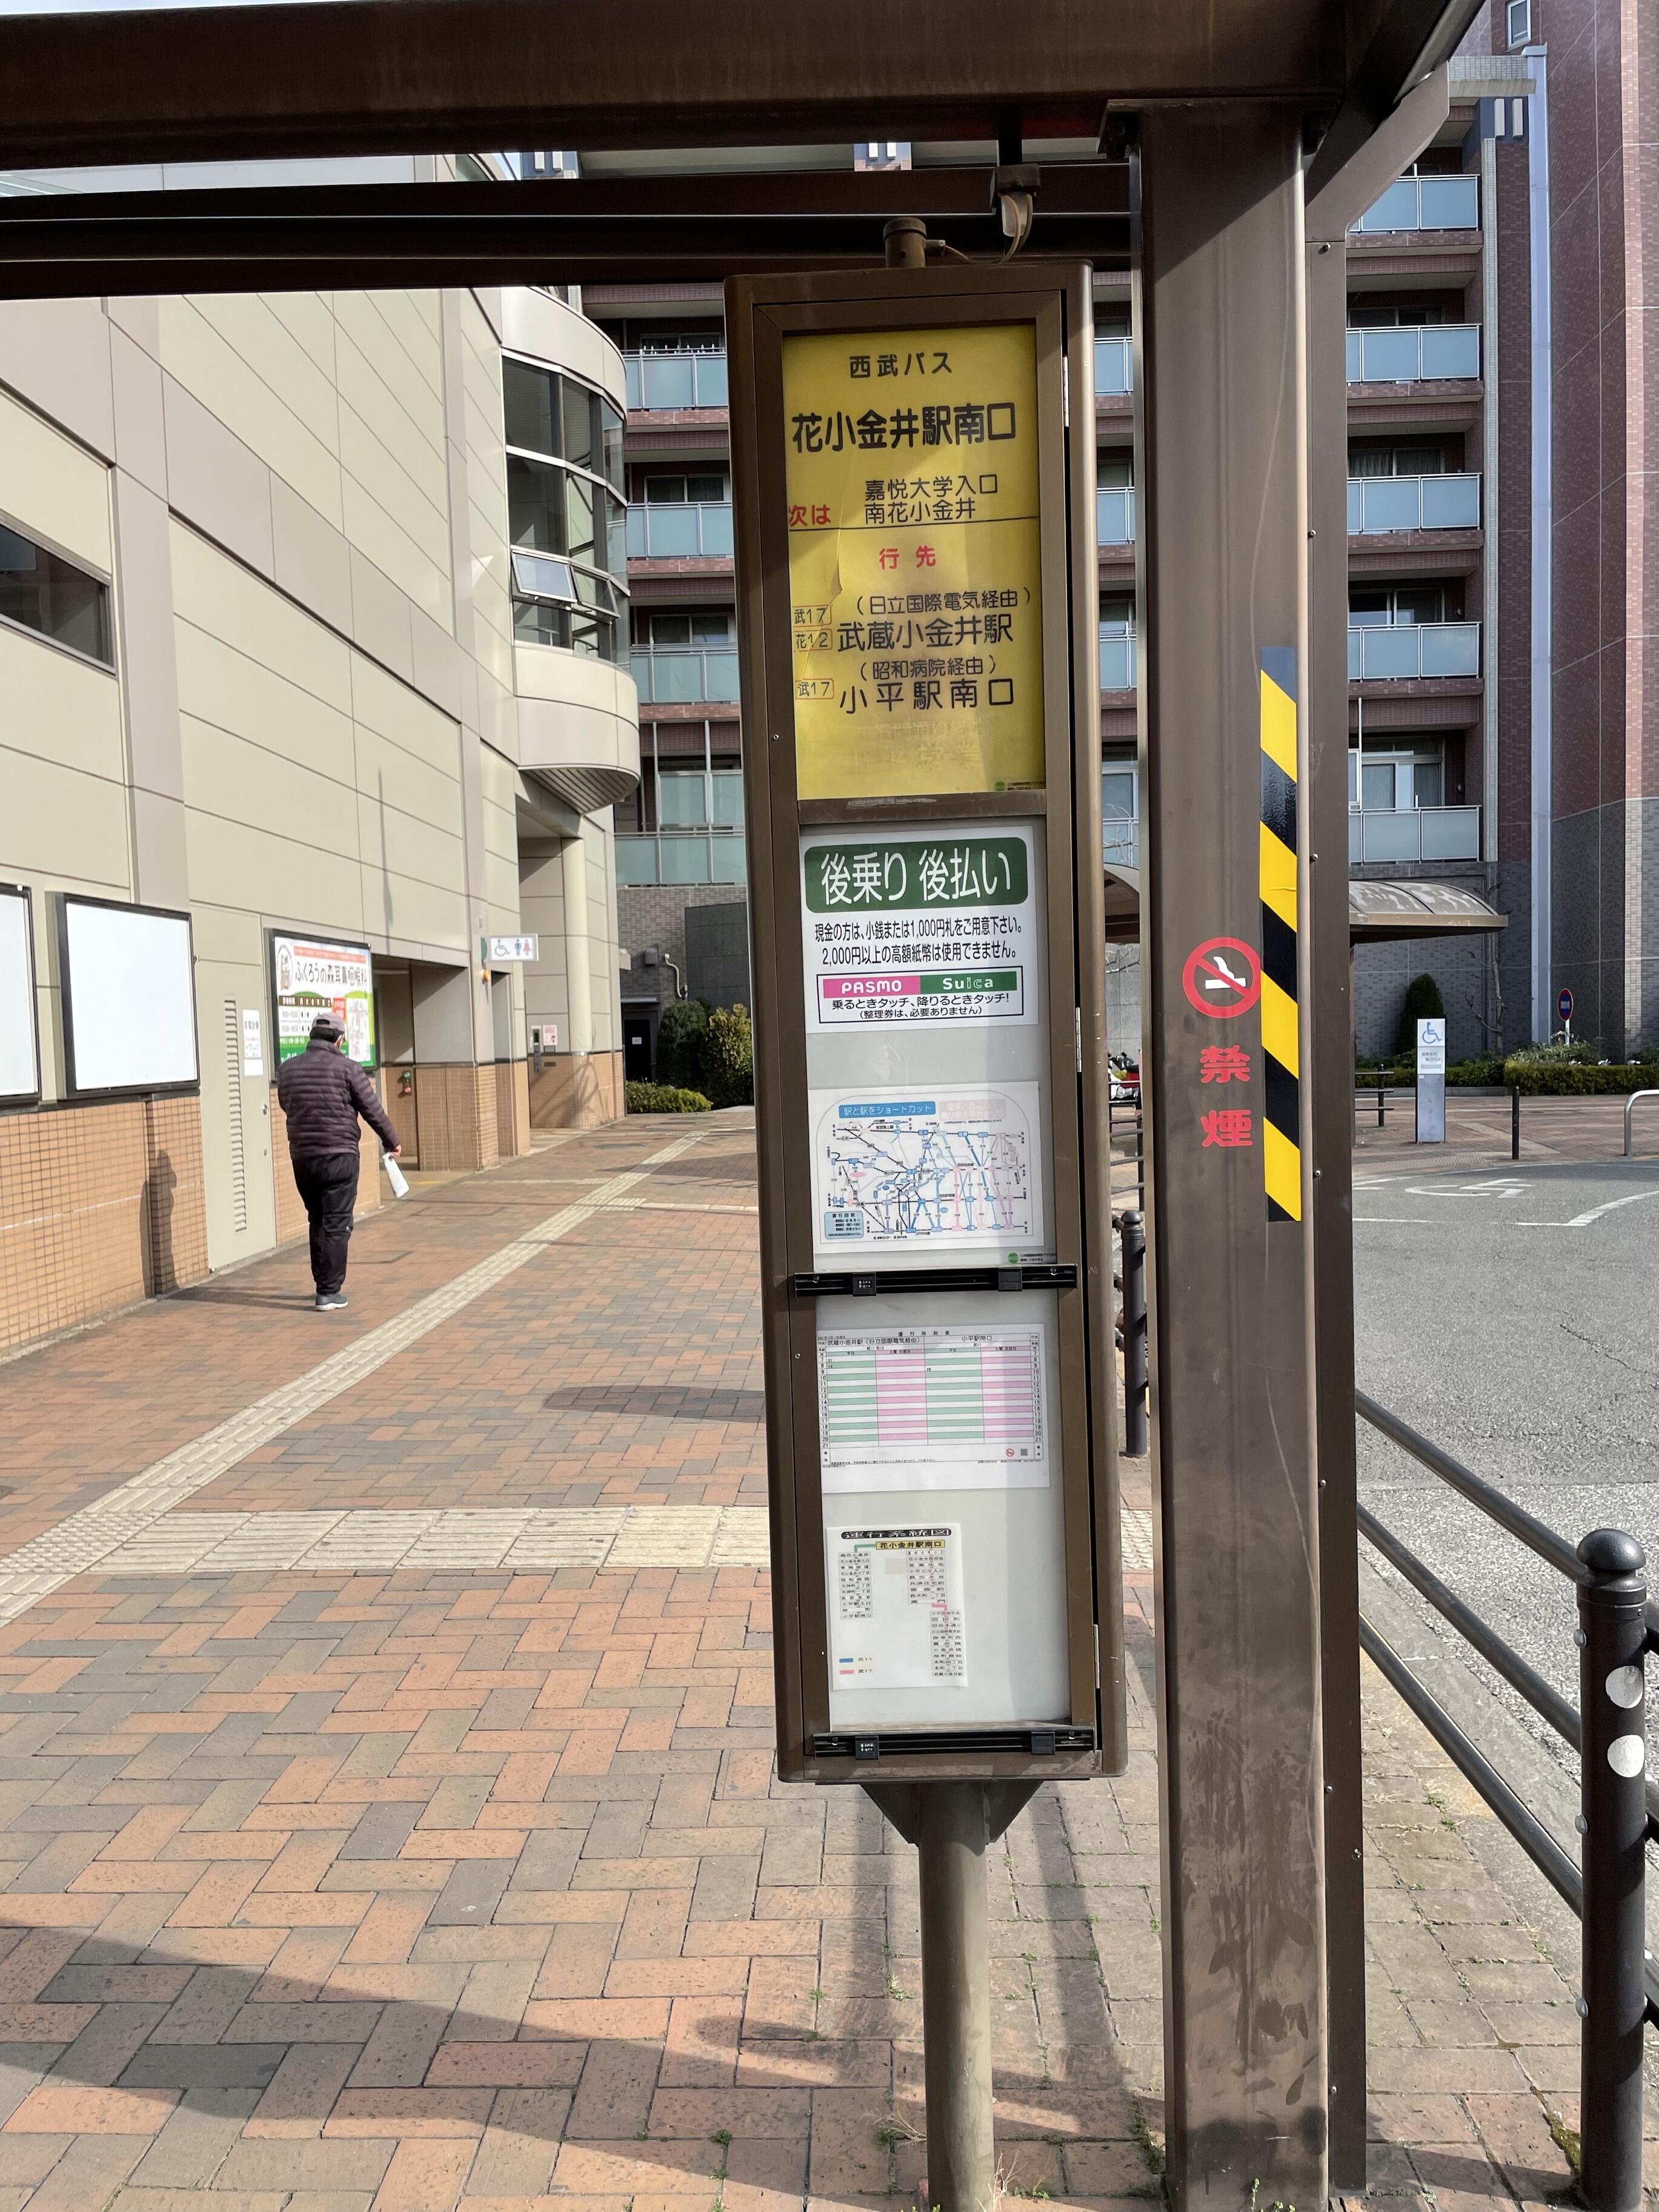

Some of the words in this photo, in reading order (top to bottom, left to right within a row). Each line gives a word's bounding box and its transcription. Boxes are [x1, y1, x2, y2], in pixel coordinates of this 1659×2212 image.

[849, 352, 952, 379] 西武バス
[791, 402, 1016, 453] 花小金井駅南口
[865, 474, 997, 501] 嘉悦大学入口
[788, 504, 831, 527] 次は
[865, 497, 976, 525] 南花小金井
[879, 545, 936, 570] 行先
[794, 608, 828, 625] 武17
[795, 632, 828, 650] 花12
[837, 614, 1013, 652] 武蔵小金井駅
[797, 681, 830, 697] 武17
[840, 678, 1014, 714] 小平駅南口
[821, 851, 906, 905] 後乗り
[919, 847, 1011, 901] 後払い
[842, 980, 902, 994] PASMO
[943, 977, 994, 990] Suica
[1200, 1045, 1252, 1146] 禁煙
[843, 1104, 931, 1117] 駅と駅をショートカット
[845, 1529, 949, 1538] 運行系統図
